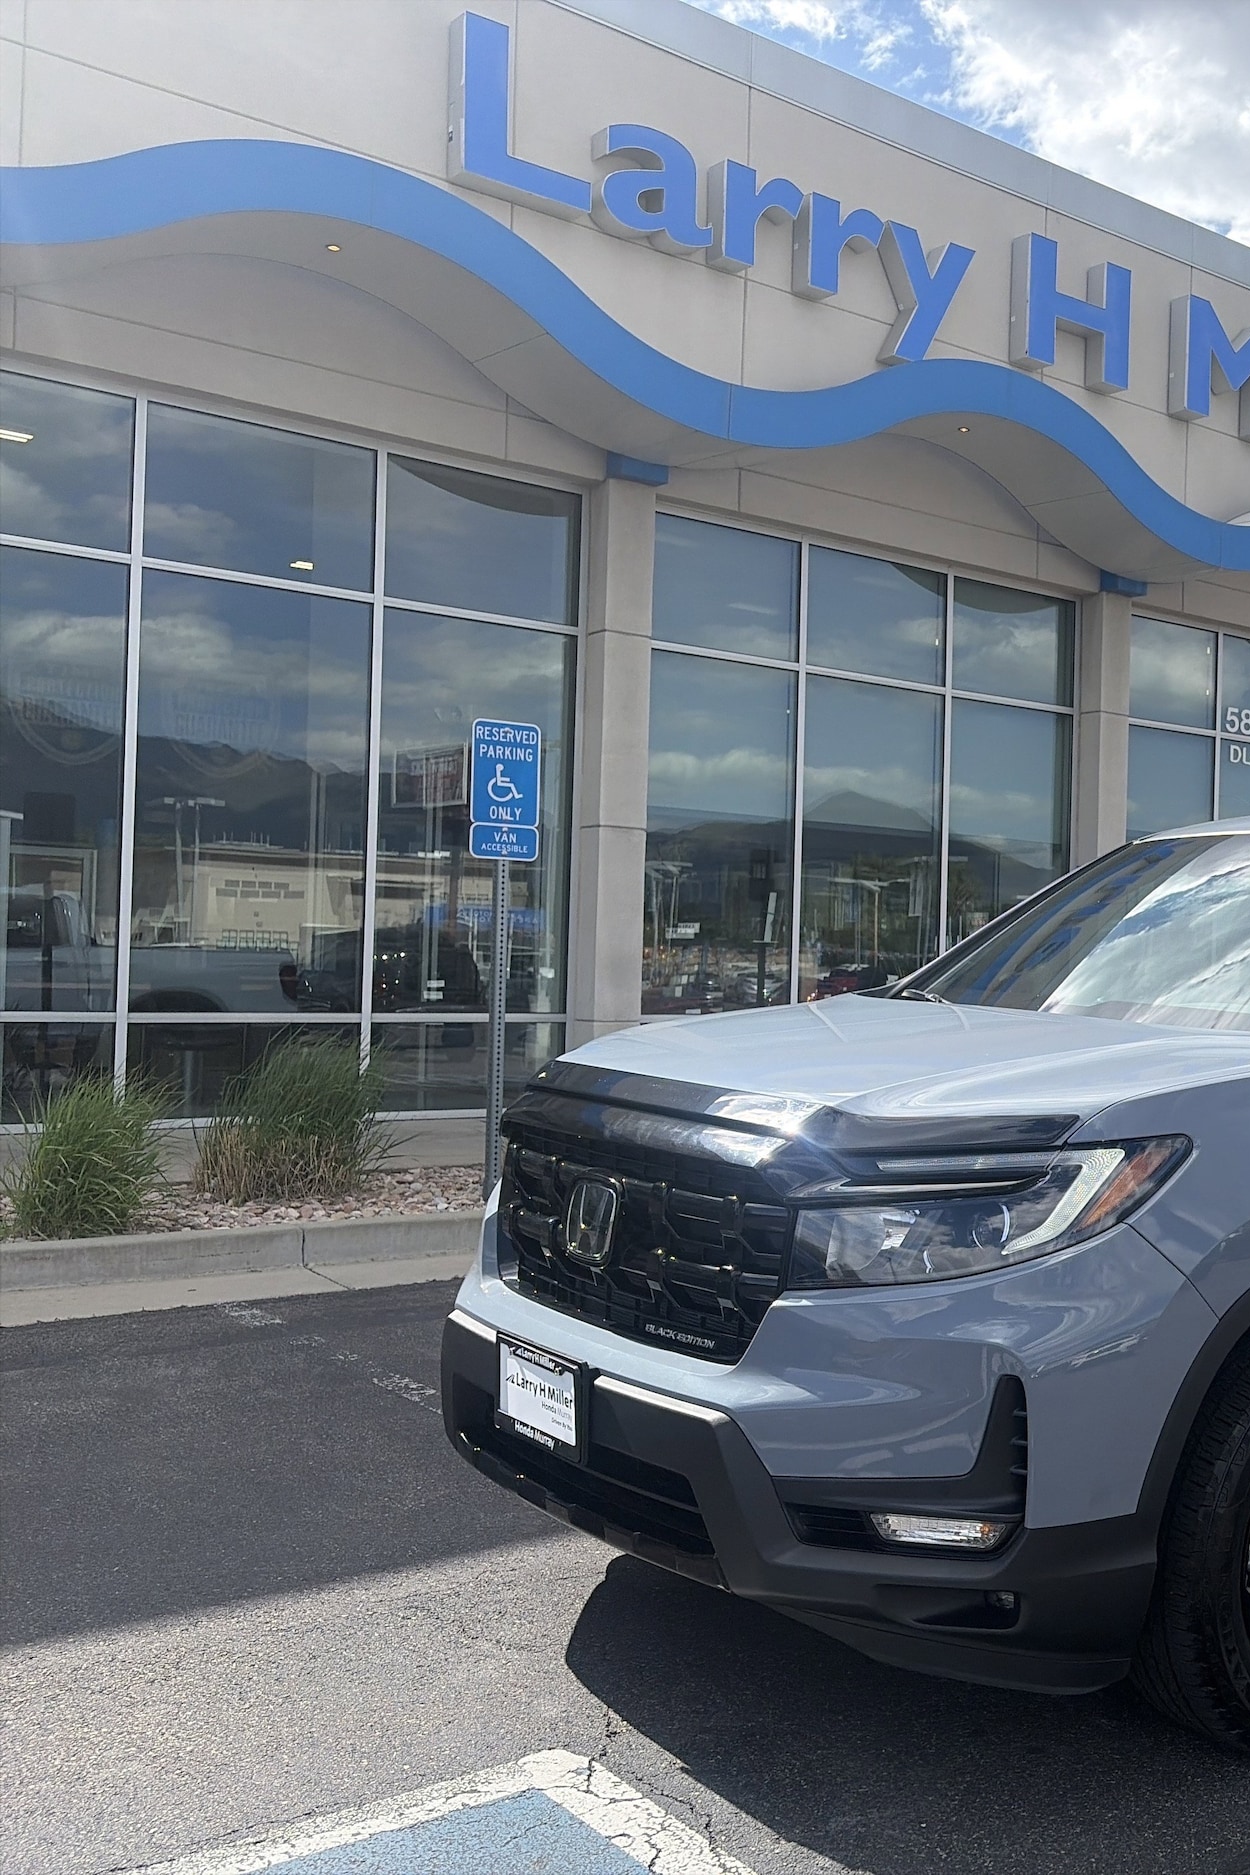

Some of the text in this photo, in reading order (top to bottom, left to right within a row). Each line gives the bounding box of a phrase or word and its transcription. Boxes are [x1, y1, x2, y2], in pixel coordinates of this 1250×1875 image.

[452, 11, 976, 364] Larry
[1013, 232, 1131, 392] H
[476, 725, 537, 745] RESERVED
[479, 743, 533, 762] PARKING
[489, 805, 522, 821] ONLY
[494, 831, 517, 844] VAN
[480, 842, 528, 854] ACCESSIBLE
[645, 1323, 716, 1349] BLACK EDITION
[516, 1372, 573, 1410] Larry H Miller
[541, 1401, 557, 1415] Honda
[514, 1420, 555, 1451] Honda Murray
